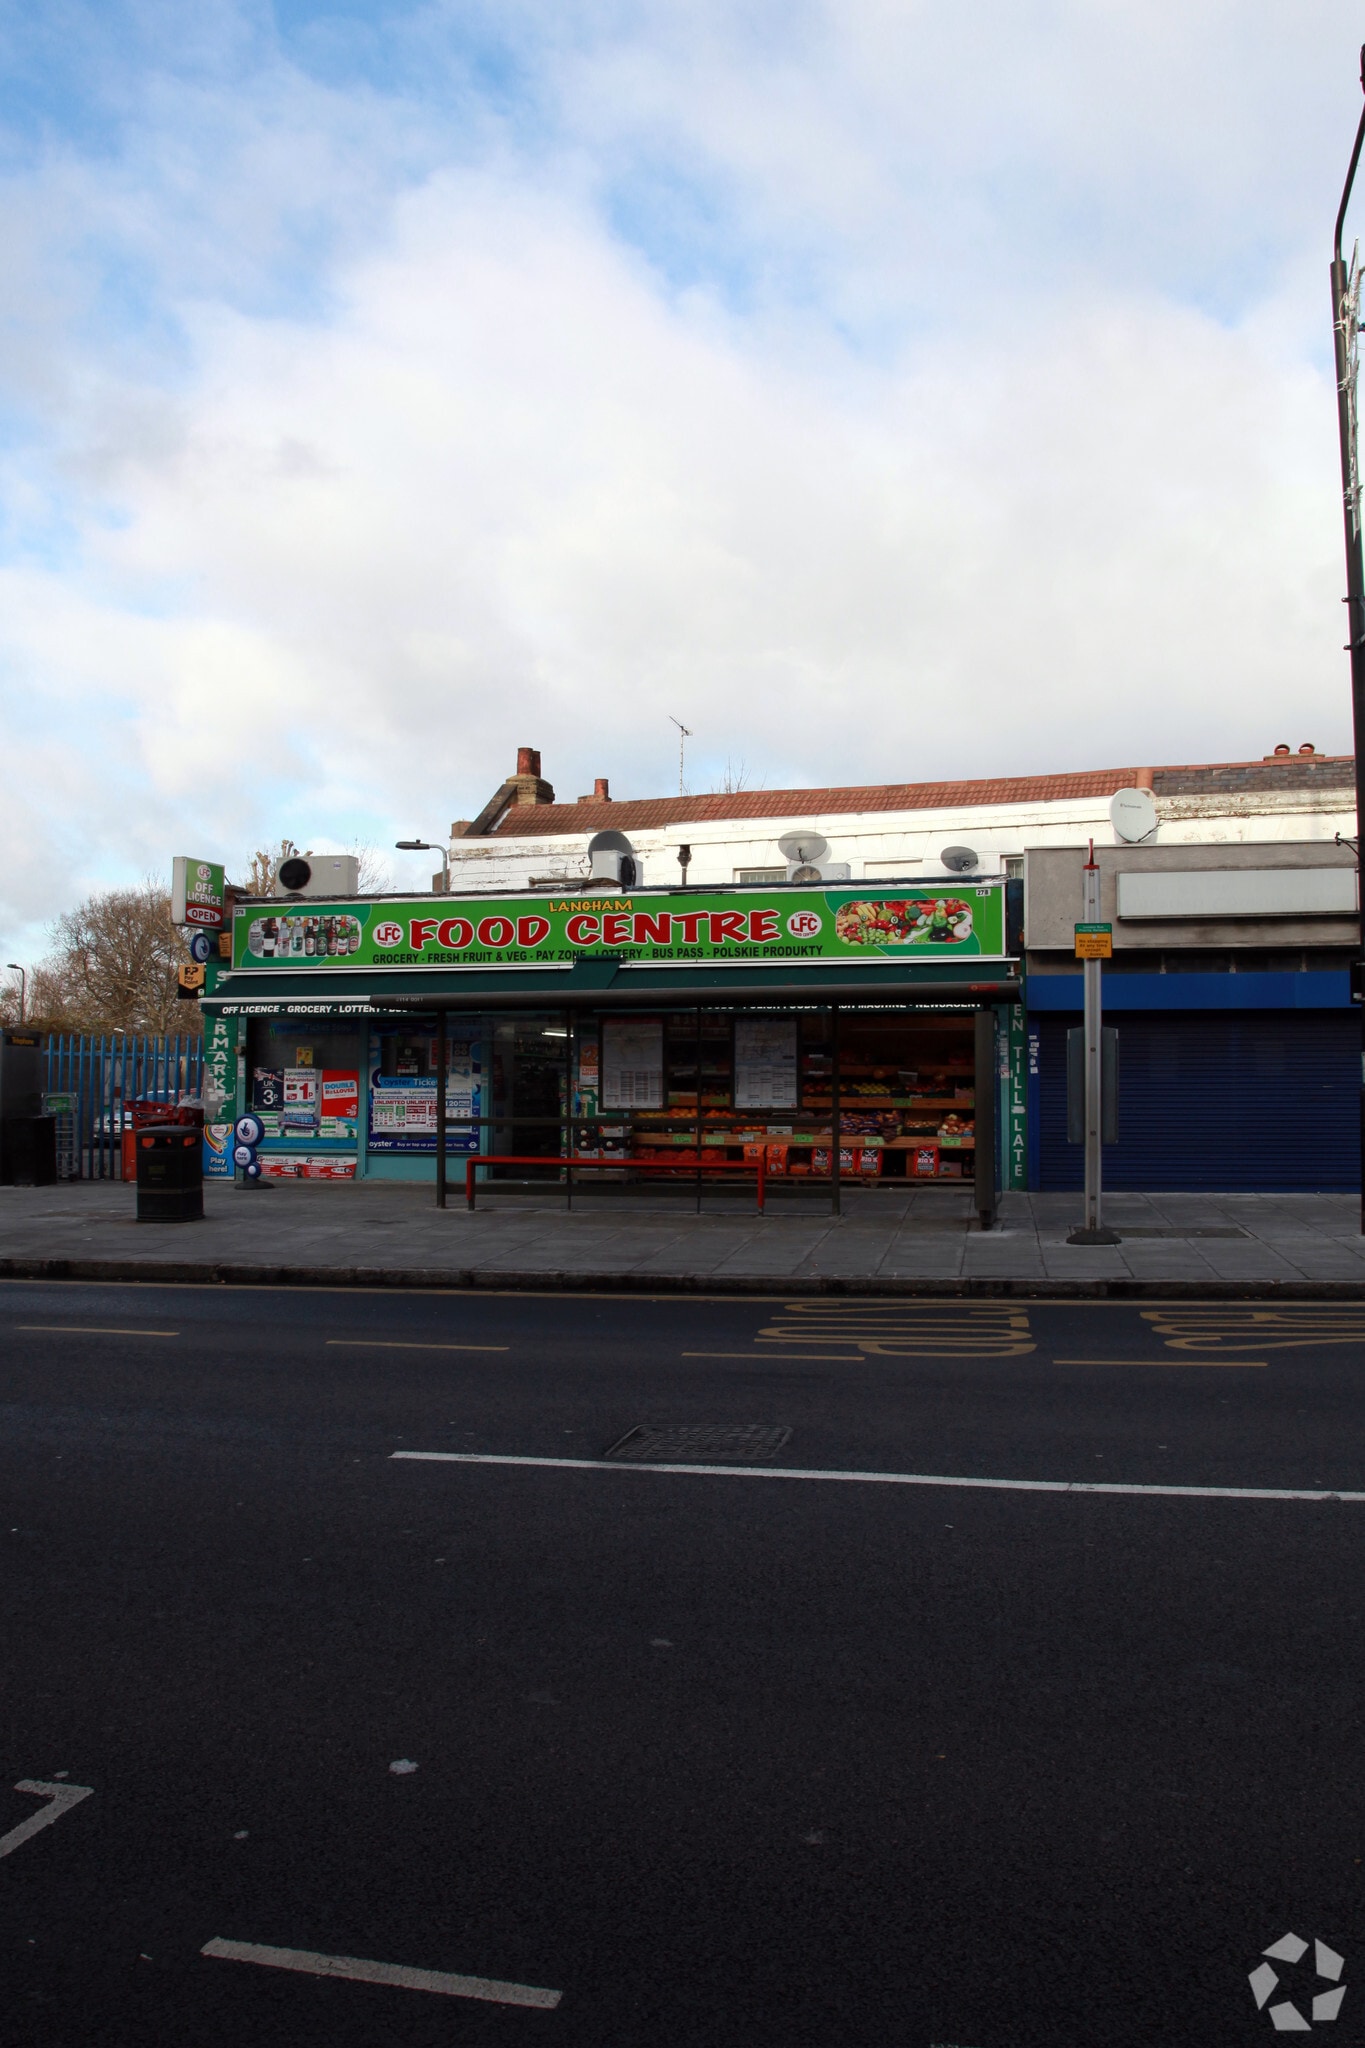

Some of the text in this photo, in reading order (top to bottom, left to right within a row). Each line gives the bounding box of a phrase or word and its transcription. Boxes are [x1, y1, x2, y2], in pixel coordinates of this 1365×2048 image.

[195, 881, 214, 894] OFF
[187, 891, 221, 906] LICENCE
[549, 898, 634, 913] LANGHAM
[191, 909, 216, 921] OPEN
[409, 909, 783, 951] FOOD CENTRE
[790, 916, 818, 932] LFC
[377, 926, 401, 942] LFC
[372, 953, 419, 964] GROCERY
[427, 952, 460, 963] FRESH
[462, 951, 493, 962] FRUIT
[496, 951, 503, 961] &
[507, 951, 528, 962] VEG
[535, 950, 556, 961] PAY
[652, 948, 674, 959] BUS
[676, 947, 704, 958] PASS
[712, 946, 760, 958] POLSKIE
[762, 945, 824, 957] PRODUKTY
[222, 1006, 239, 1014] OFF
[239, 1005, 280, 1014] LICENCE
[287, 1005, 333, 1013] GROCERY
[1012, 1046, 1023, 1105] TILL
[324, 1082, 355, 1090] DOUBLE
[383, 1079, 410, 1088] oyster
[368, 1140, 394, 1148] oyster
[1012, 1118, 1024, 1177] LATE
[209, 1156, 226, 1165] Play
[208, 1165, 228, 1173] here!
